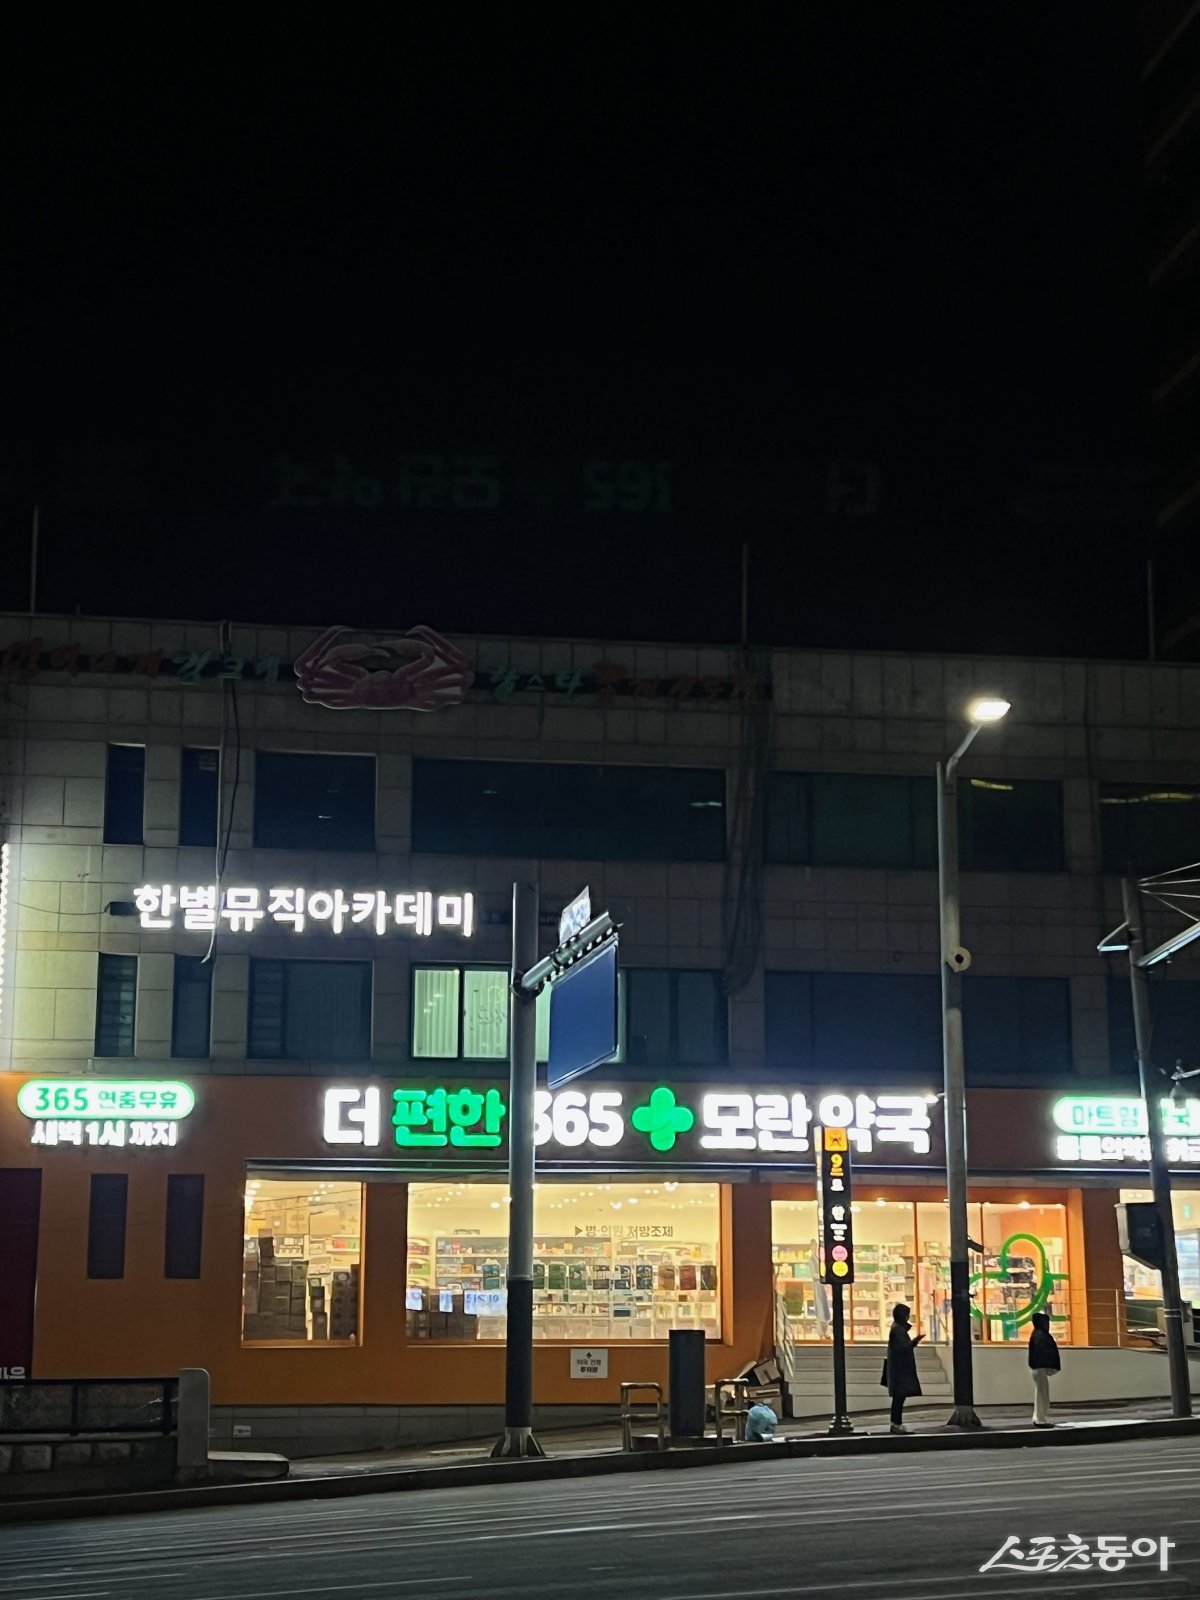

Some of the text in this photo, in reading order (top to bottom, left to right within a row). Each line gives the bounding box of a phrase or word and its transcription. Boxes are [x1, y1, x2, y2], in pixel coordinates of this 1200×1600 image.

[133, 884, 473, 937] 한별뮤직아카데미
[35, 1087, 177, 1111] 365 연중무휴
[323, 1087, 380, 1146] 더
[392, 1088, 505, 1147] 편한
[31, 1120, 82, 1145] 새벽
[626, 1225, 673, 1239] 처방조제
